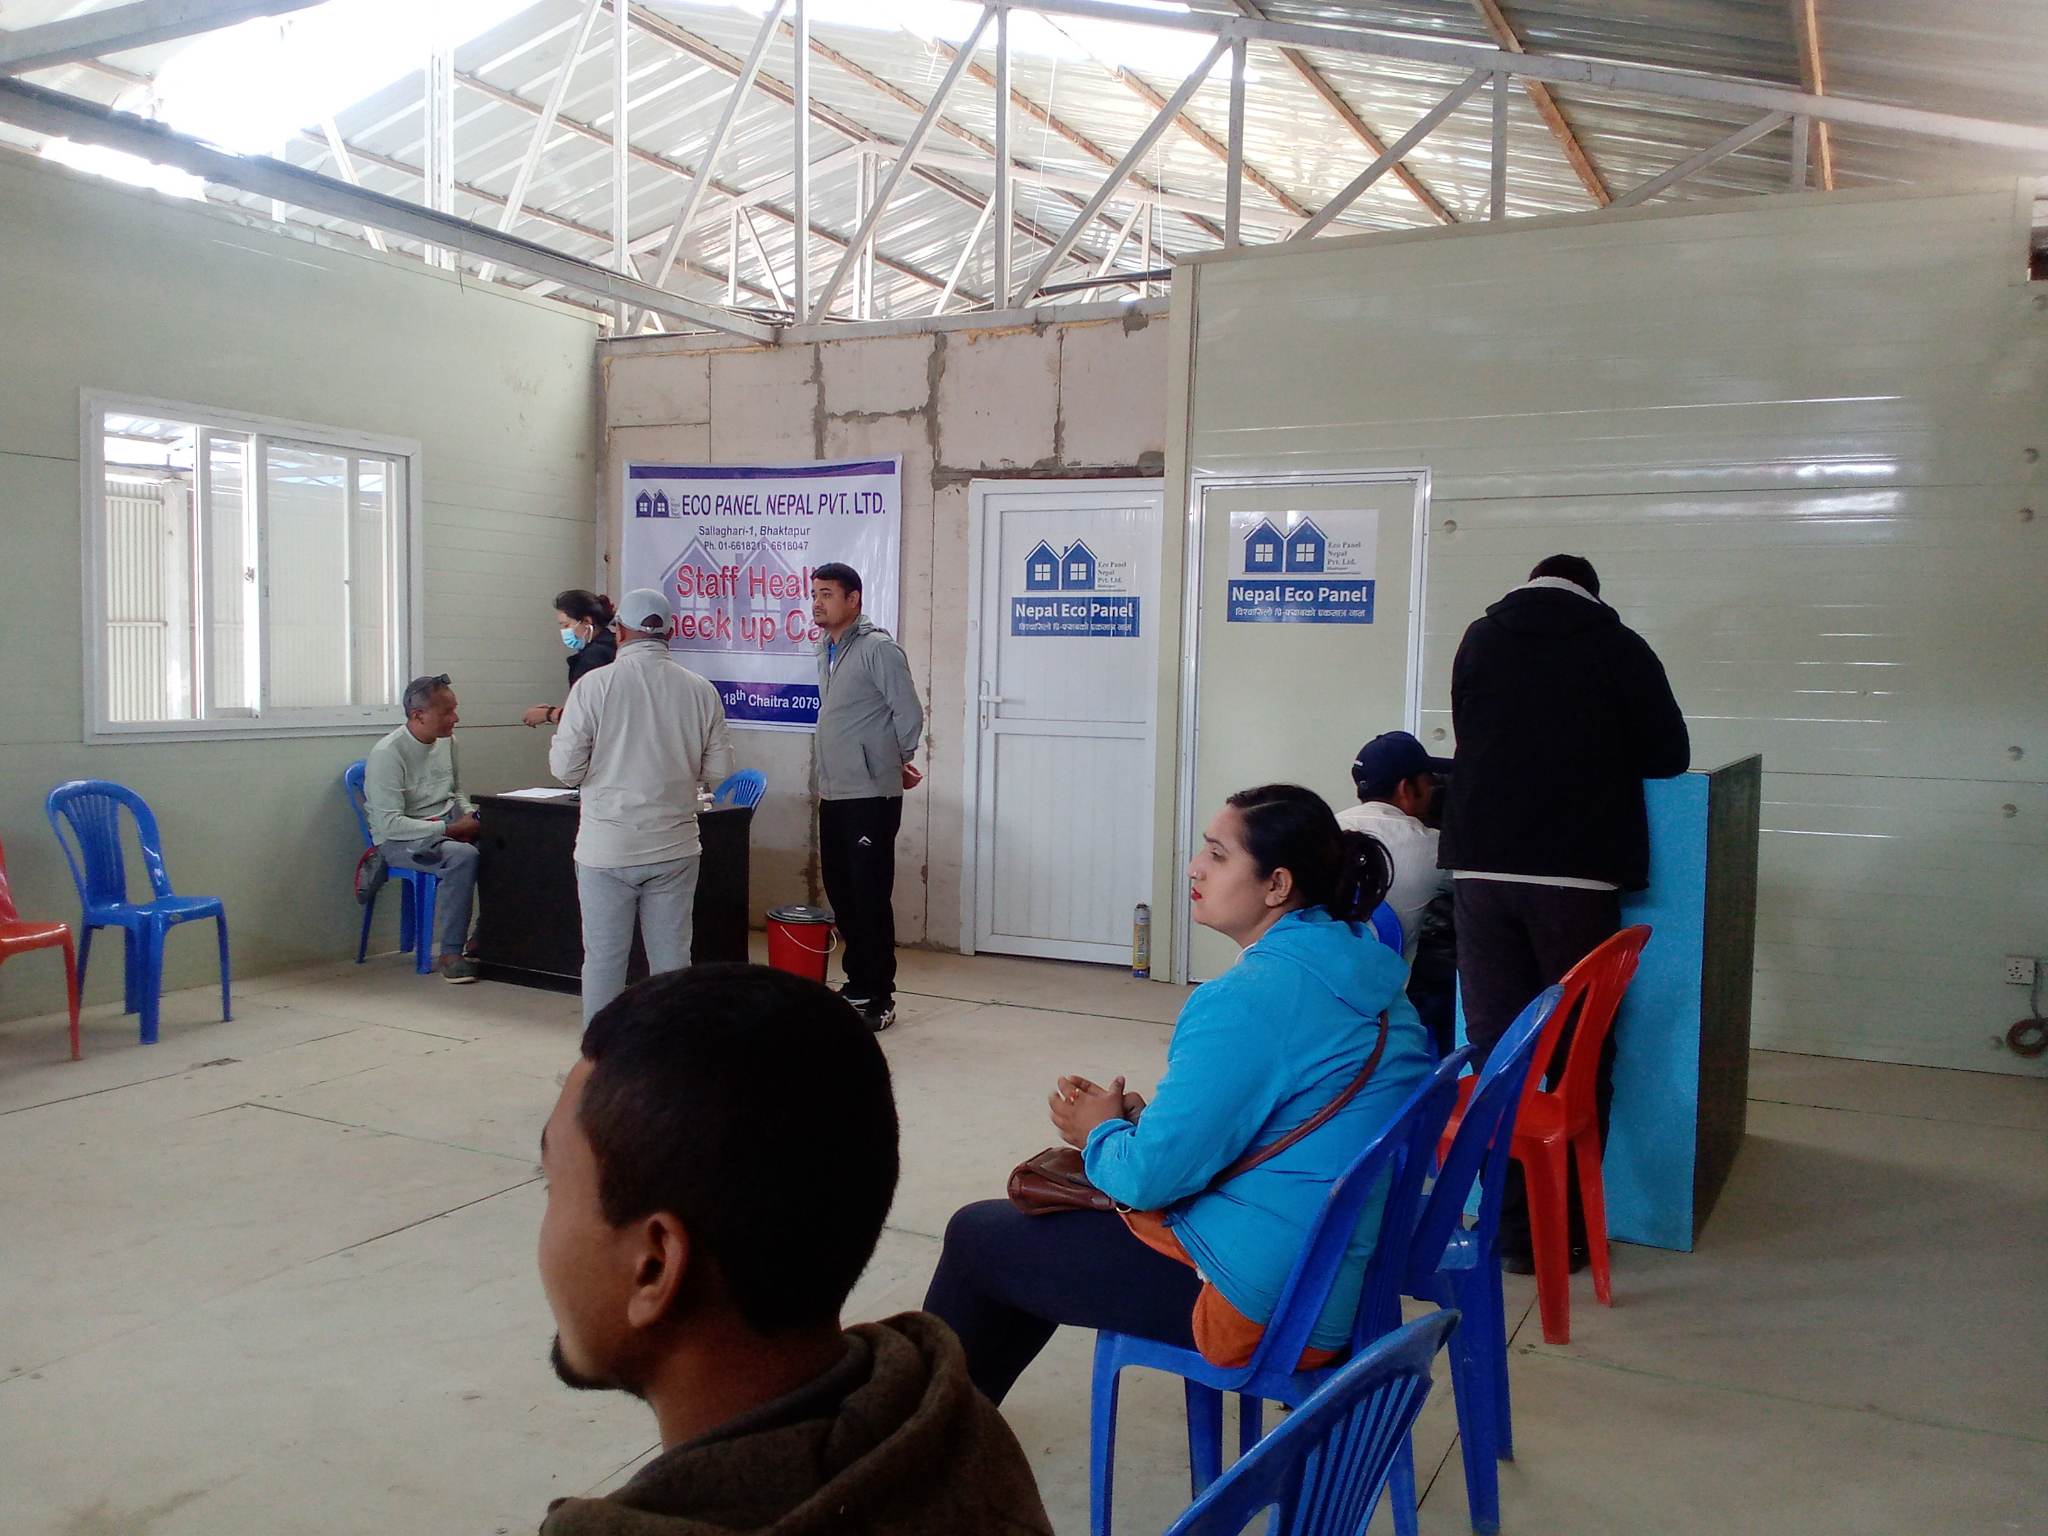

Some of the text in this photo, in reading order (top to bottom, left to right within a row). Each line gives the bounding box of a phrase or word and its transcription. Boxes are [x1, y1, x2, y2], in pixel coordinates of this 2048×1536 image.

[682, 494, 711, 516] ECO
[715, 494, 762, 516] PANEL
[766, 493, 814, 516] NEPAL
[818, 493, 849, 515] PVT.
[854, 492, 886, 515] LTD.
[698, 525, 811, 538] Sallaghari-1, Bhaktapur
[704, 541, 716, 551] Ph.
[676, 564, 817, 600] Staff Heal
[1232, 586, 1368, 604] Nepal Eco Panel
[1015, 603, 1133, 620] Nepal Eco Panel
[740, 613, 776, 650] up
[785, 609, 824, 644] Ca
[723, 689, 820, 709] 18th Chaitra 2079
